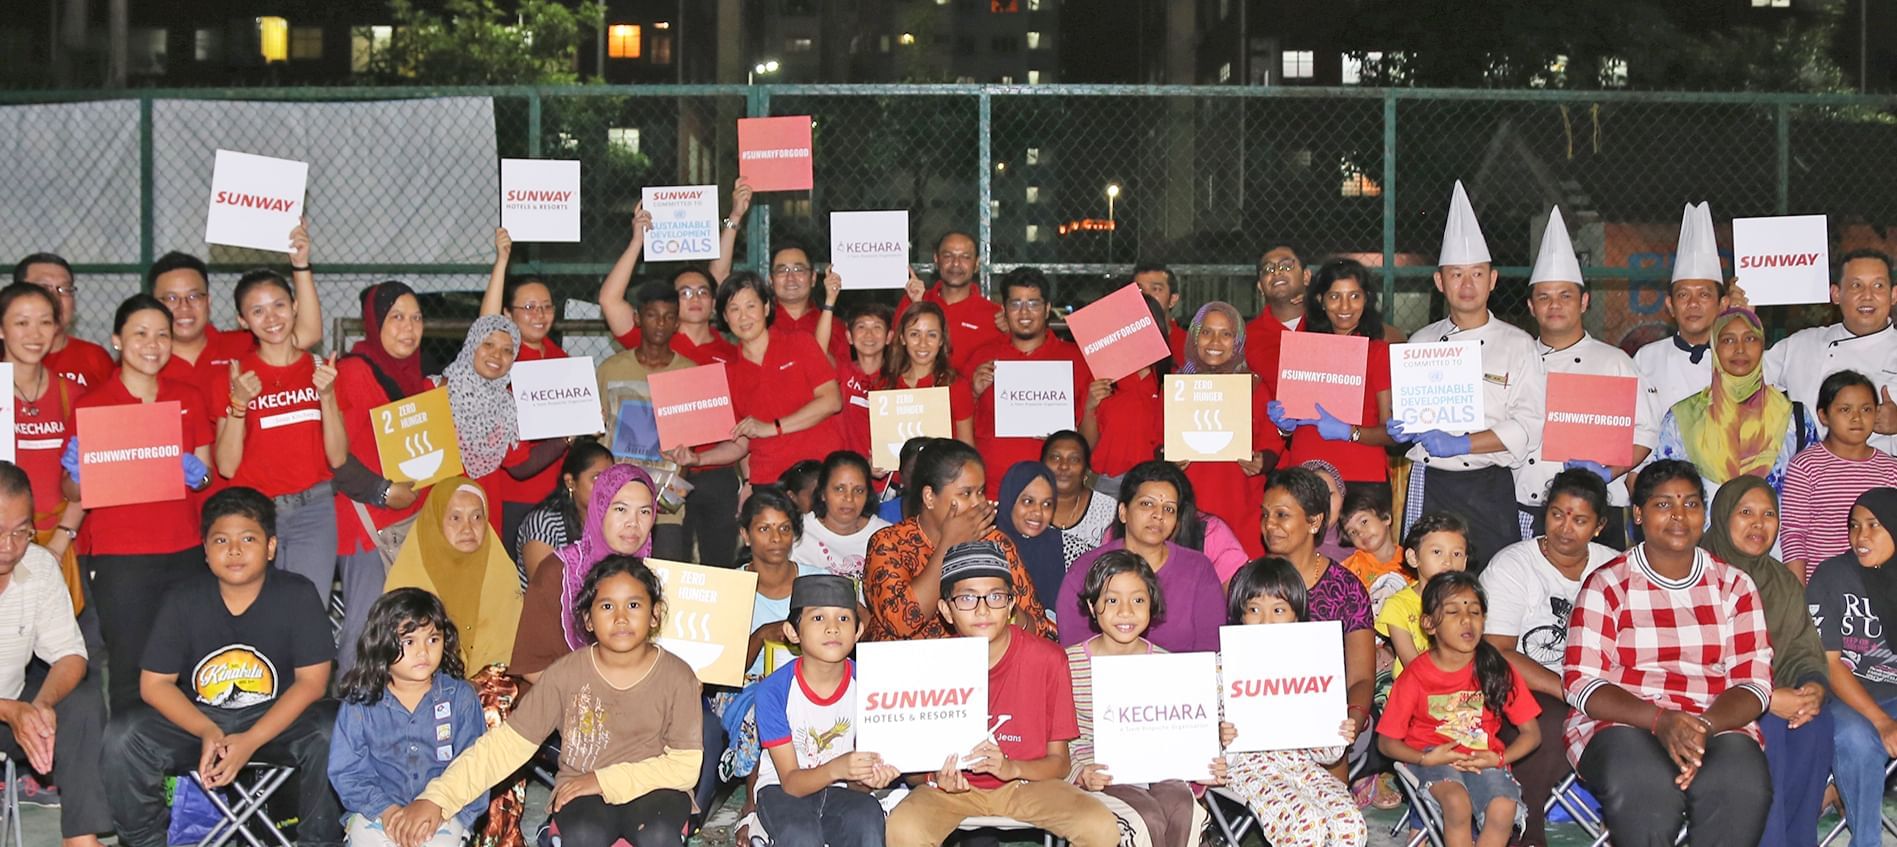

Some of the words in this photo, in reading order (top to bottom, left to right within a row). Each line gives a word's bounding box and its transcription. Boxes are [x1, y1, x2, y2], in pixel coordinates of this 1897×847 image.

[742, 148, 809, 160] #SUNWAYFORGOOD
[215, 191, 295, 213] SUNWAY
[506, 190, 572, 201] SUNWAY
[653, 191, 703, 201] SUNWAY
[650, 229, 711, 239] DEVELOPMENT
[651, 238, 712, 254] GOALS
[846, 241, 902, 253] KECHARA
[1740, 252, 1819, 268] SUNWAY
[1084, 315, 1152, 356] #SUNWAYFORGOOD
[1403, 347, 1464, 359] SUNWAY
[1403, 359, 1450, 368] COMMITTED
[1281, 369, 1362, 386] #SUNWAYFORGOOD
[530, 387, 592, 401] KECHARA
[1010, 390, 1067, 401] KECHARA
[1174, 380, 1185, 402] 2
[1401, 384, 1474, 396] SUSTAINABLE
[657, 395, 729, 417] #SUNWAYFORGOOD
[878, 395, 889, 416] 2
[1401, 395, 1474, 407] DEVELOPMENT
[398, 402, 417, 416] ZERO
[1402, 405, 1475, 425] GOALS
[382, 410, 395, 434] 2
[1547, 411, 1632, 427] #SUNWAYFORGOOD
[83, 444, 180, 465] #SUNWAYFORGOOD
[681, 571, 706, 585] ZERO
[1230, 675, 1334, 698] SUNWAY
[865, 687, 975, 711] SUNWAY
[864, 713, 905, 724] HOTELS
[909, 713, 916, 722] &
[919, 709, 967, 721] RESORTS
[1118, 703, 1208, 723] KECHARA
[997, 733, 1022, 743] Jeans
